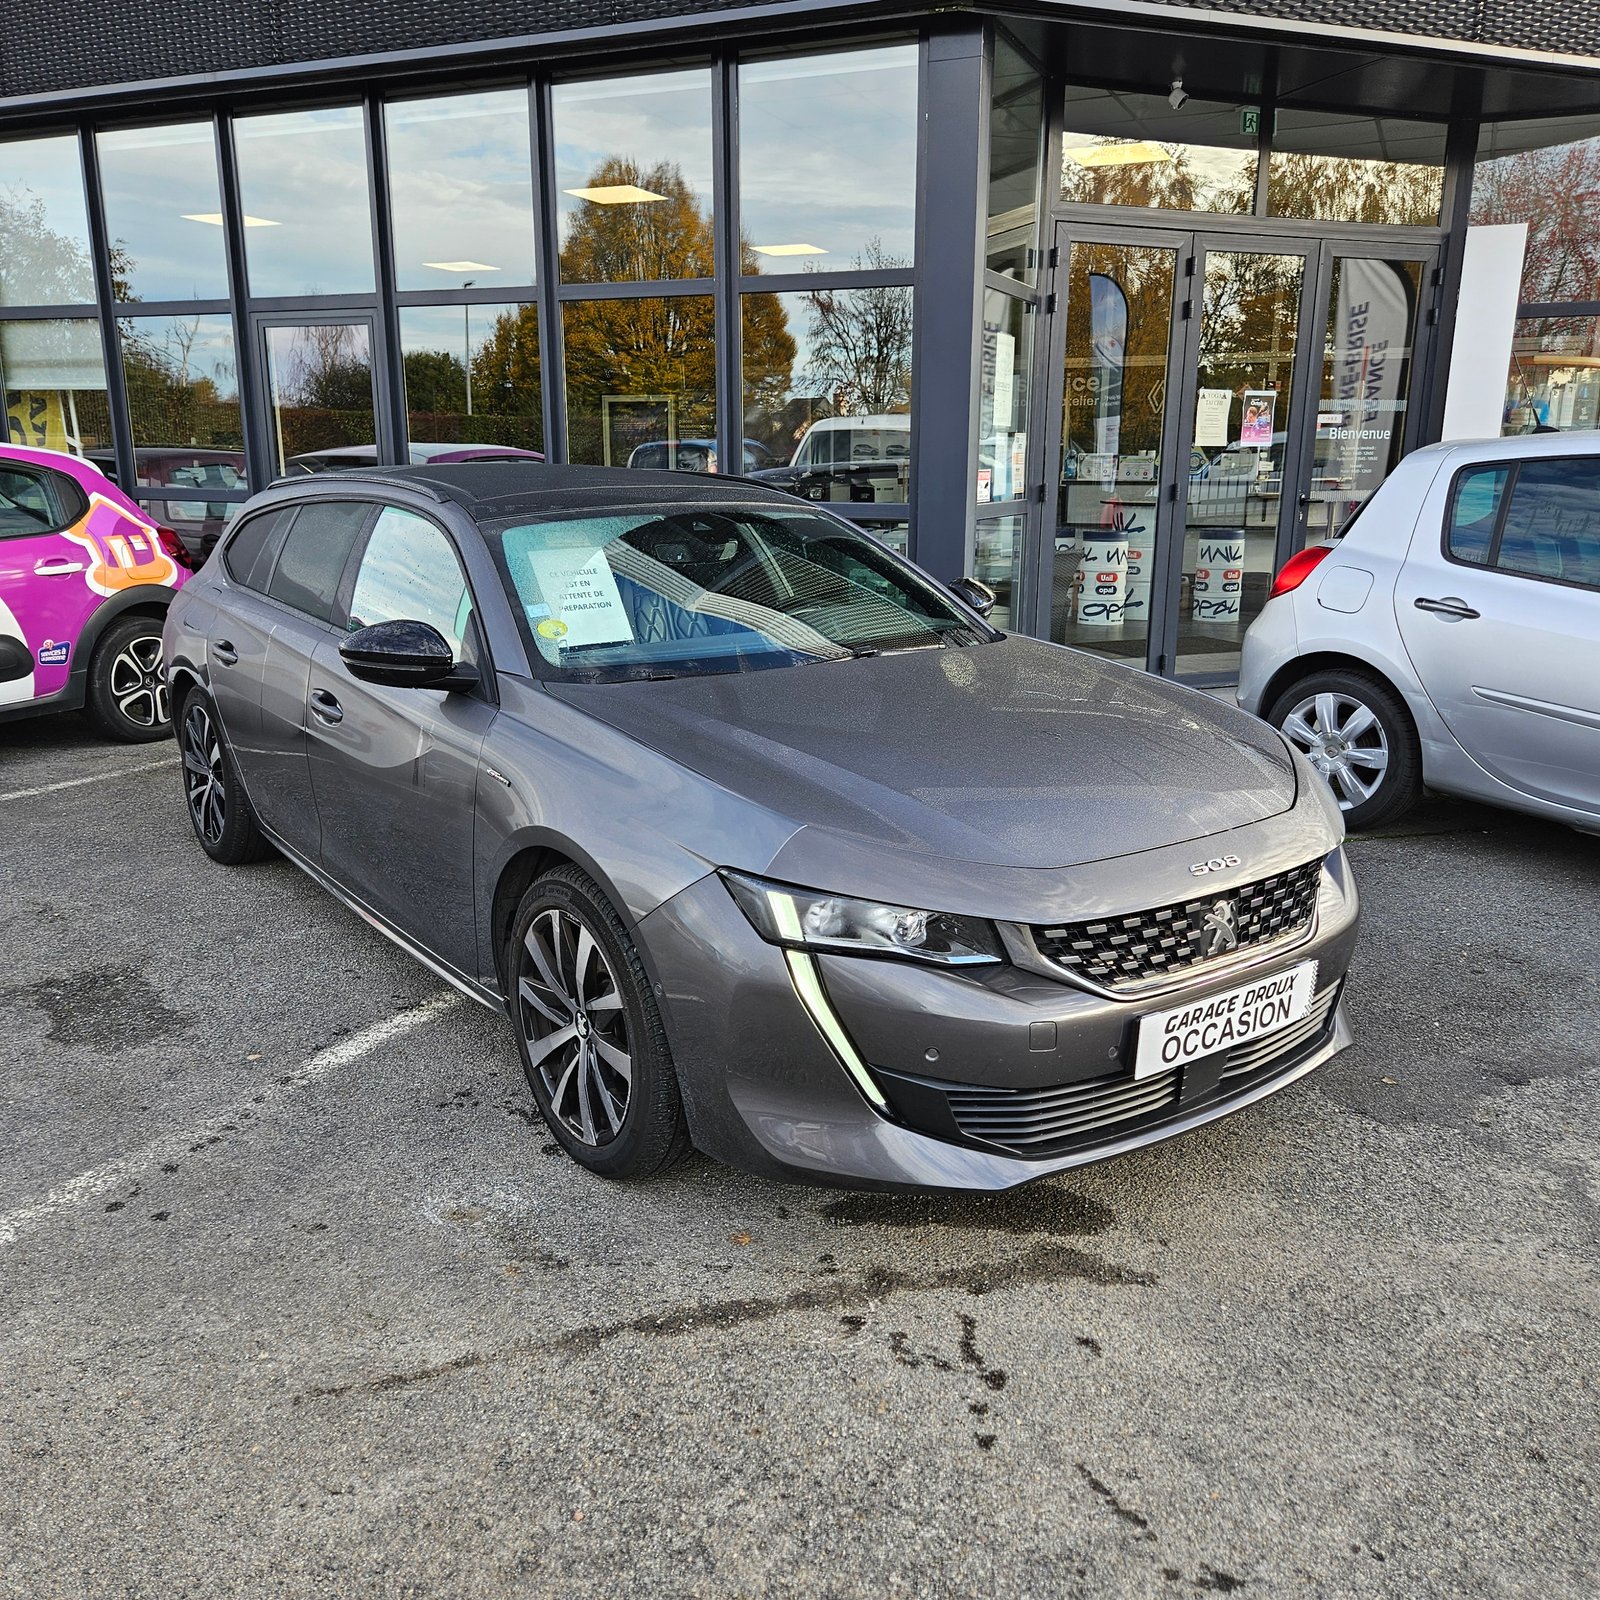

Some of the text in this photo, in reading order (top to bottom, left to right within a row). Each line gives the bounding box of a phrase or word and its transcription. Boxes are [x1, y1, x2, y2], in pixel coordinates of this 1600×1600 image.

[1329, 427, 1391, 440] Bienvenue
[1100, 574, 1114, 582] Unil
[558, 590, 605, 601] ATTENTE DE
[1098, 586, 1115, 595] opal
[1189, 854, 1241, 877] 508
[1164, 972, 1299, 1035] GARAGE DROUX
[1161, 994, 1292, 1064] OCCASION
